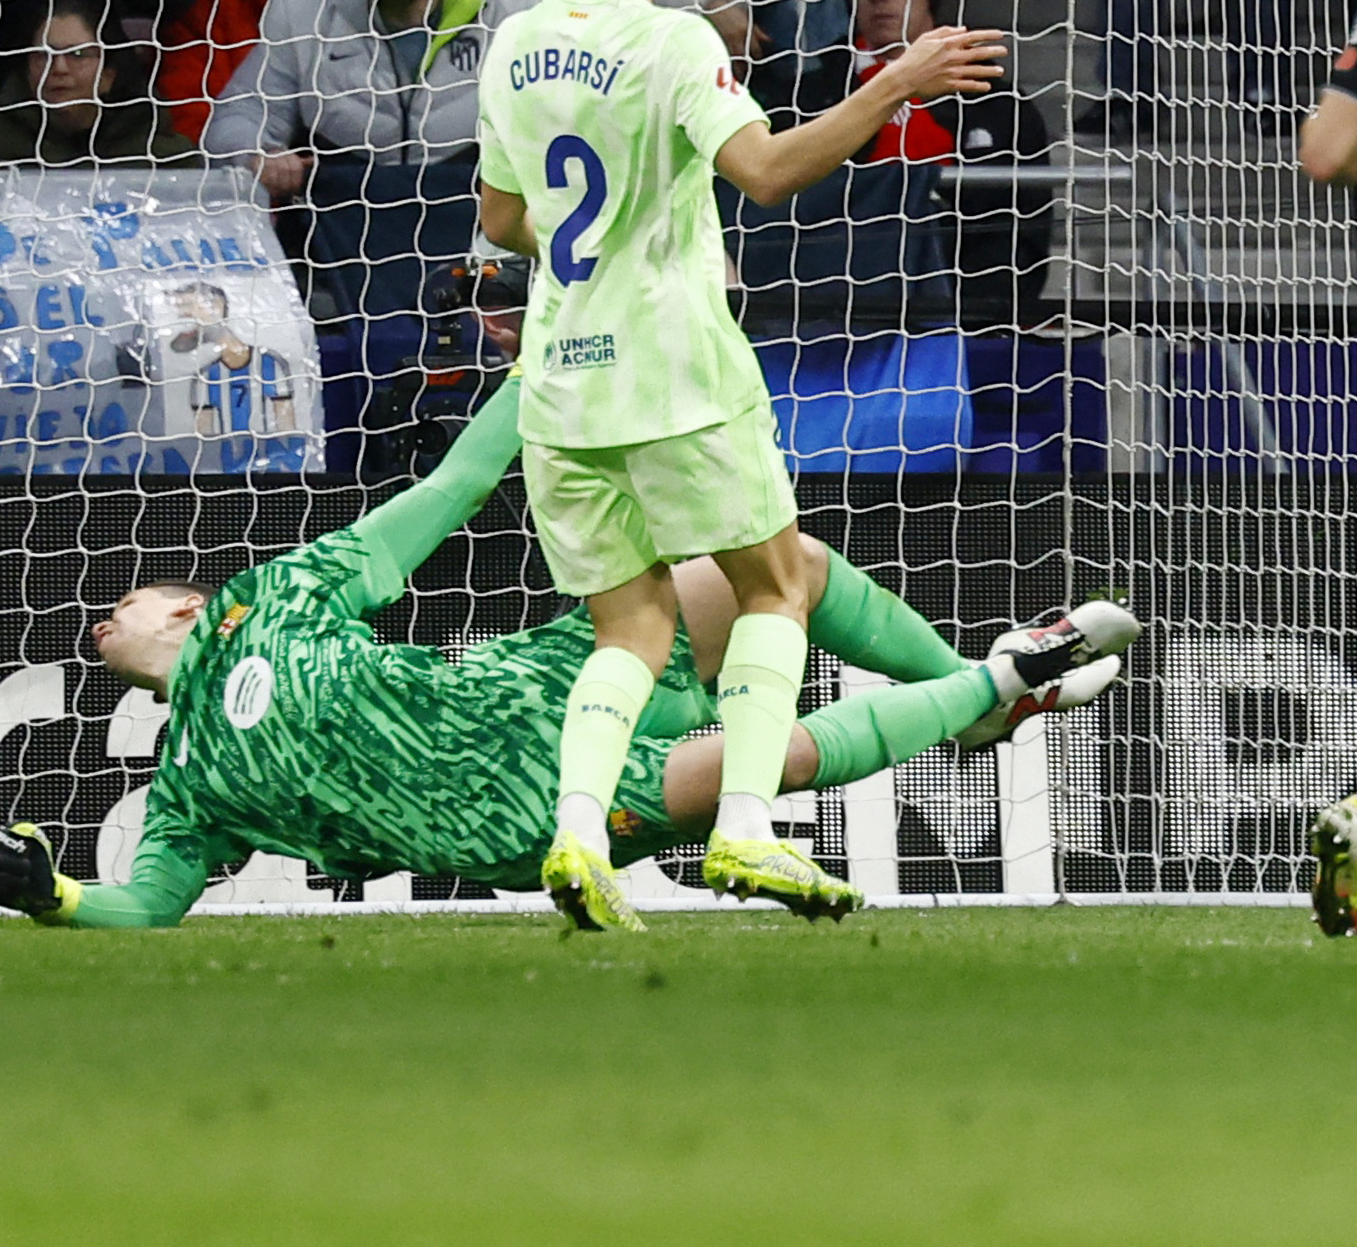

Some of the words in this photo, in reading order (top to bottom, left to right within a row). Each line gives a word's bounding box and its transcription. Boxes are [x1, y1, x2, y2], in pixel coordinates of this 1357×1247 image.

[510, 48, 624, 96] CUBARSÍ
[545, 134, 607, 286] 2
[36, 284, 105, 329] EL
[559, 334, 615, 352] UNHCR
[561, 348, 616, 365] ACNUR
